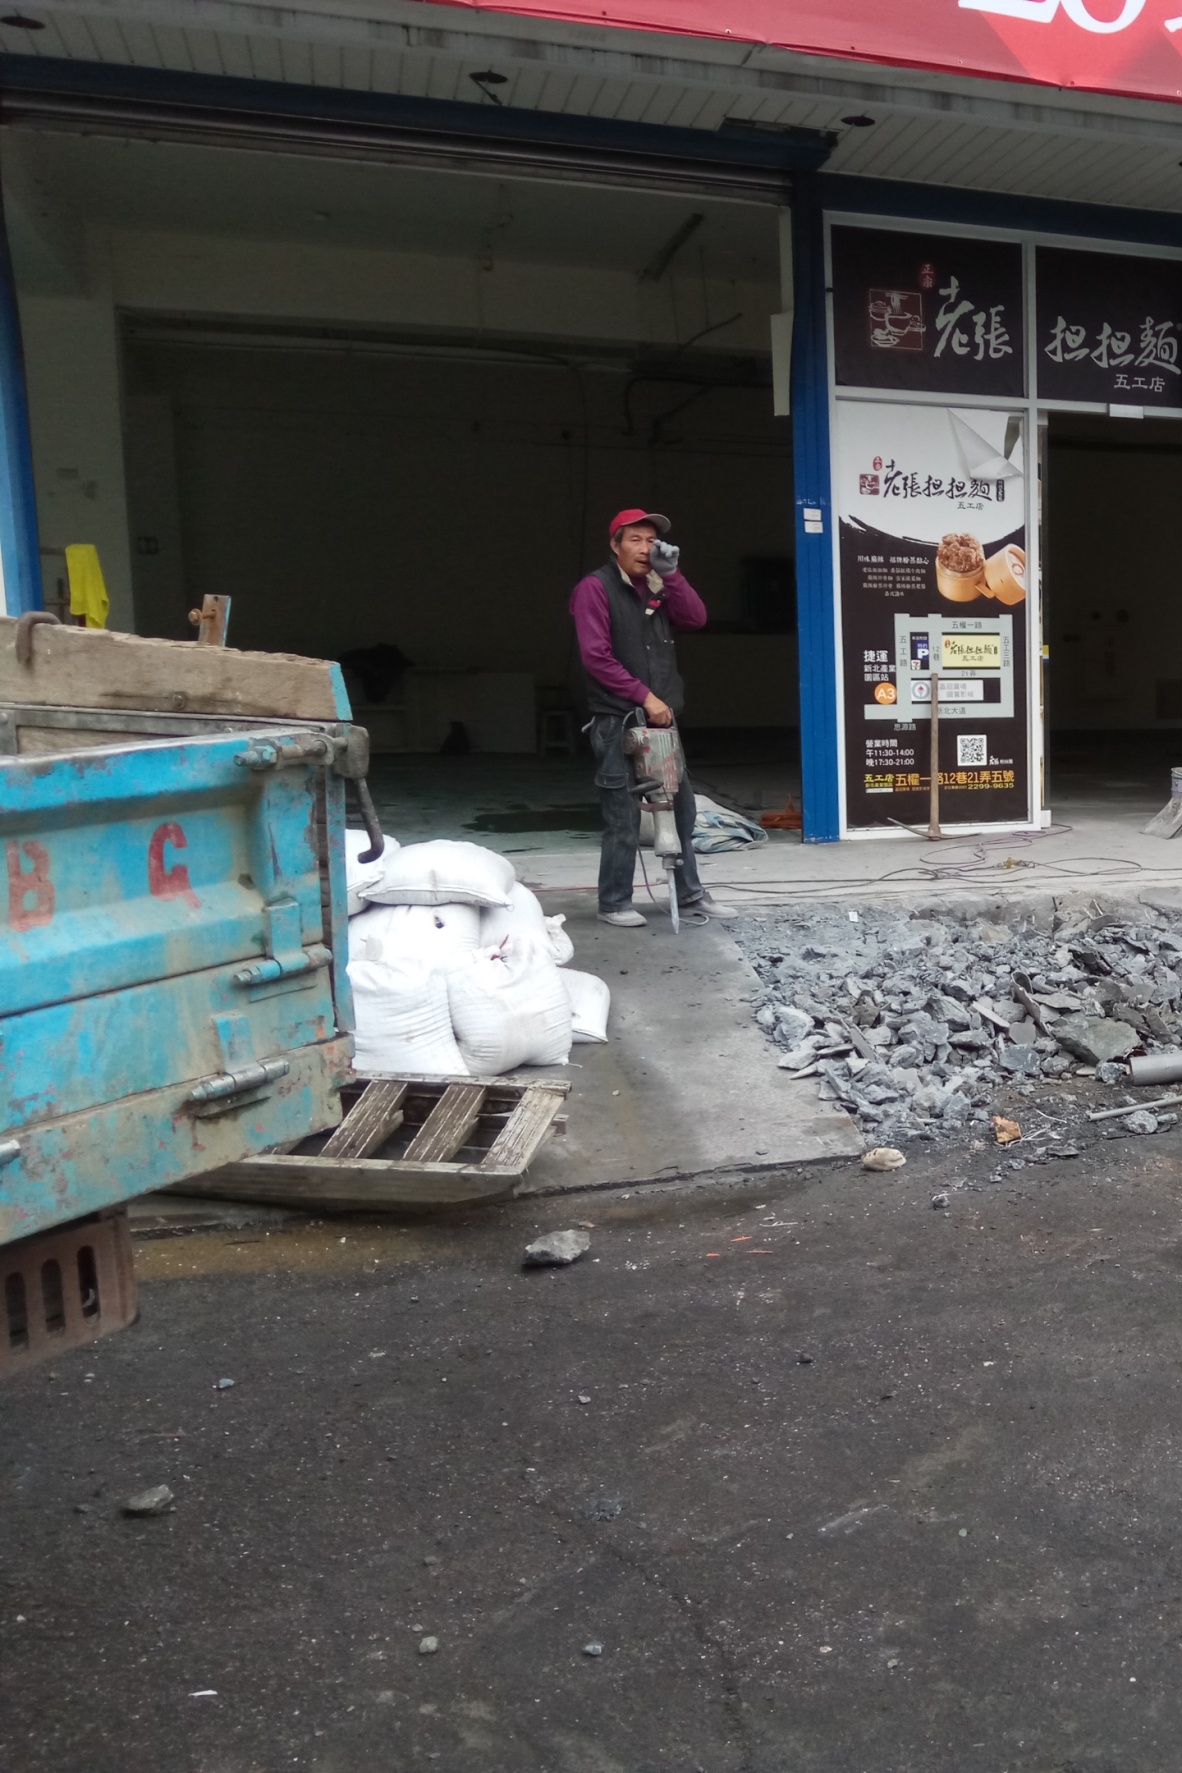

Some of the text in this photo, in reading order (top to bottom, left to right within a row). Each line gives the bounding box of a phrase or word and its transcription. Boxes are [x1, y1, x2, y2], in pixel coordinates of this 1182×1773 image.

[934, 276, 1013, 360] 老張
[1114, 374, 1166, 392] 五工店
[957, 502, 984, 510] 五工店
[863, 649, 889, 662] 捷運
[877, 688, 896, 700] A3
[865, 739, 898, 748] 營業時間
[866, 748, 915, 758] 午11:30-14:00
[866, 758, 915, 767] 晚17:30-21:00
[864, 773, 894, 783] 五工店
